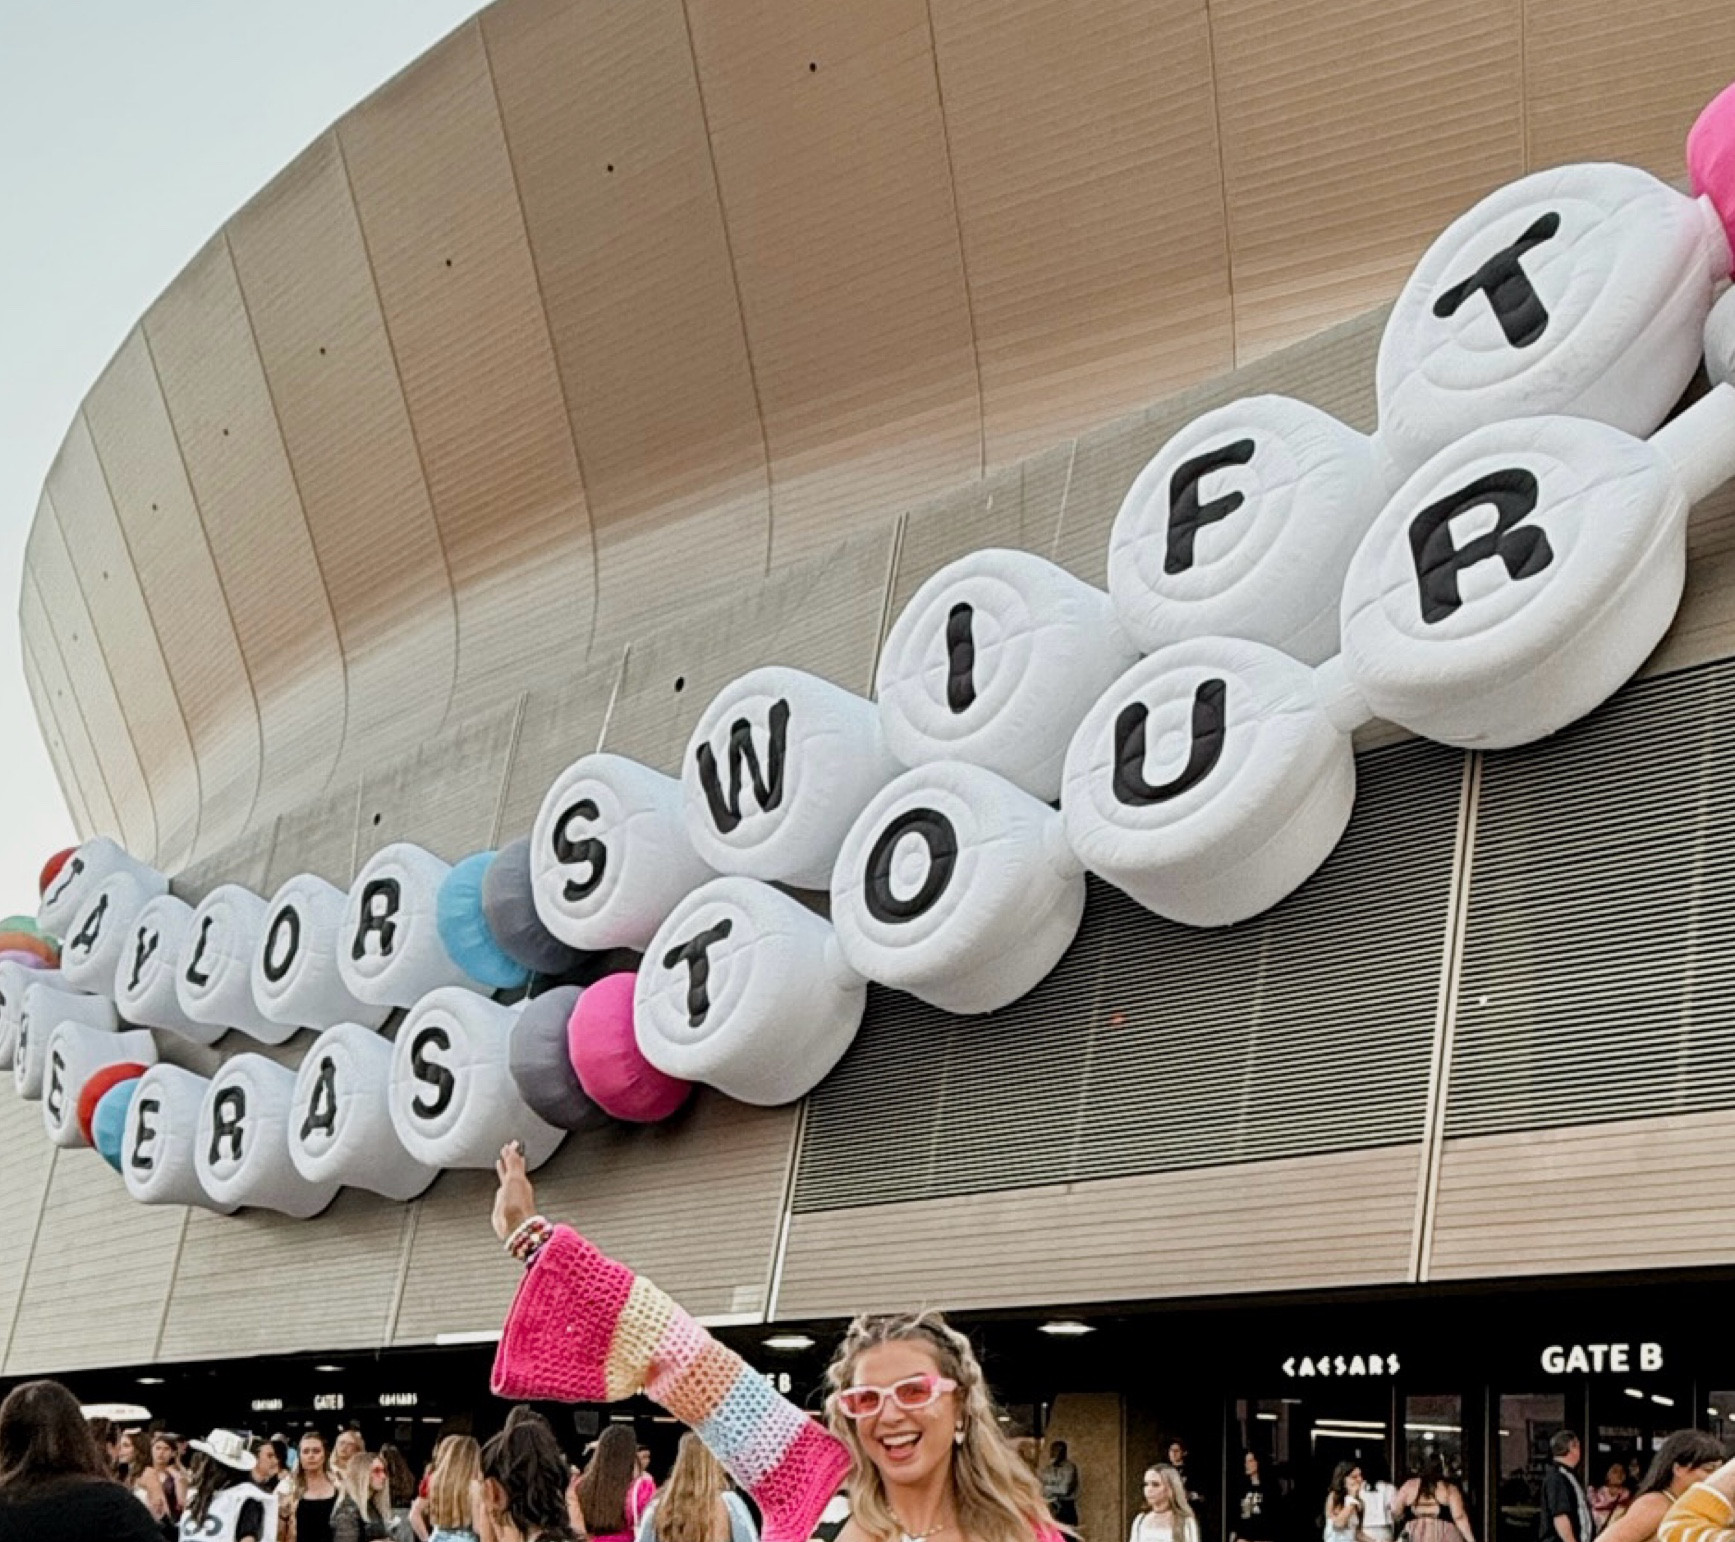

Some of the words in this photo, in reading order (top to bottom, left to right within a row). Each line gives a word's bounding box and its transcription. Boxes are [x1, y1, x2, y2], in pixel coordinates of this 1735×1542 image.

[47, 857, 401, 992] TAYLOR
[552, 211, 1561, 901] SWIFT
[132, 1026, 455, 1170] ERAS
[663, 467, 1554, 1028] TOUR
[1283, 1353, 1400, 1377] CAESARS
[1541, 1345, 1629, 1373] GATE
[1640, 1343, 1663, 1371] B
